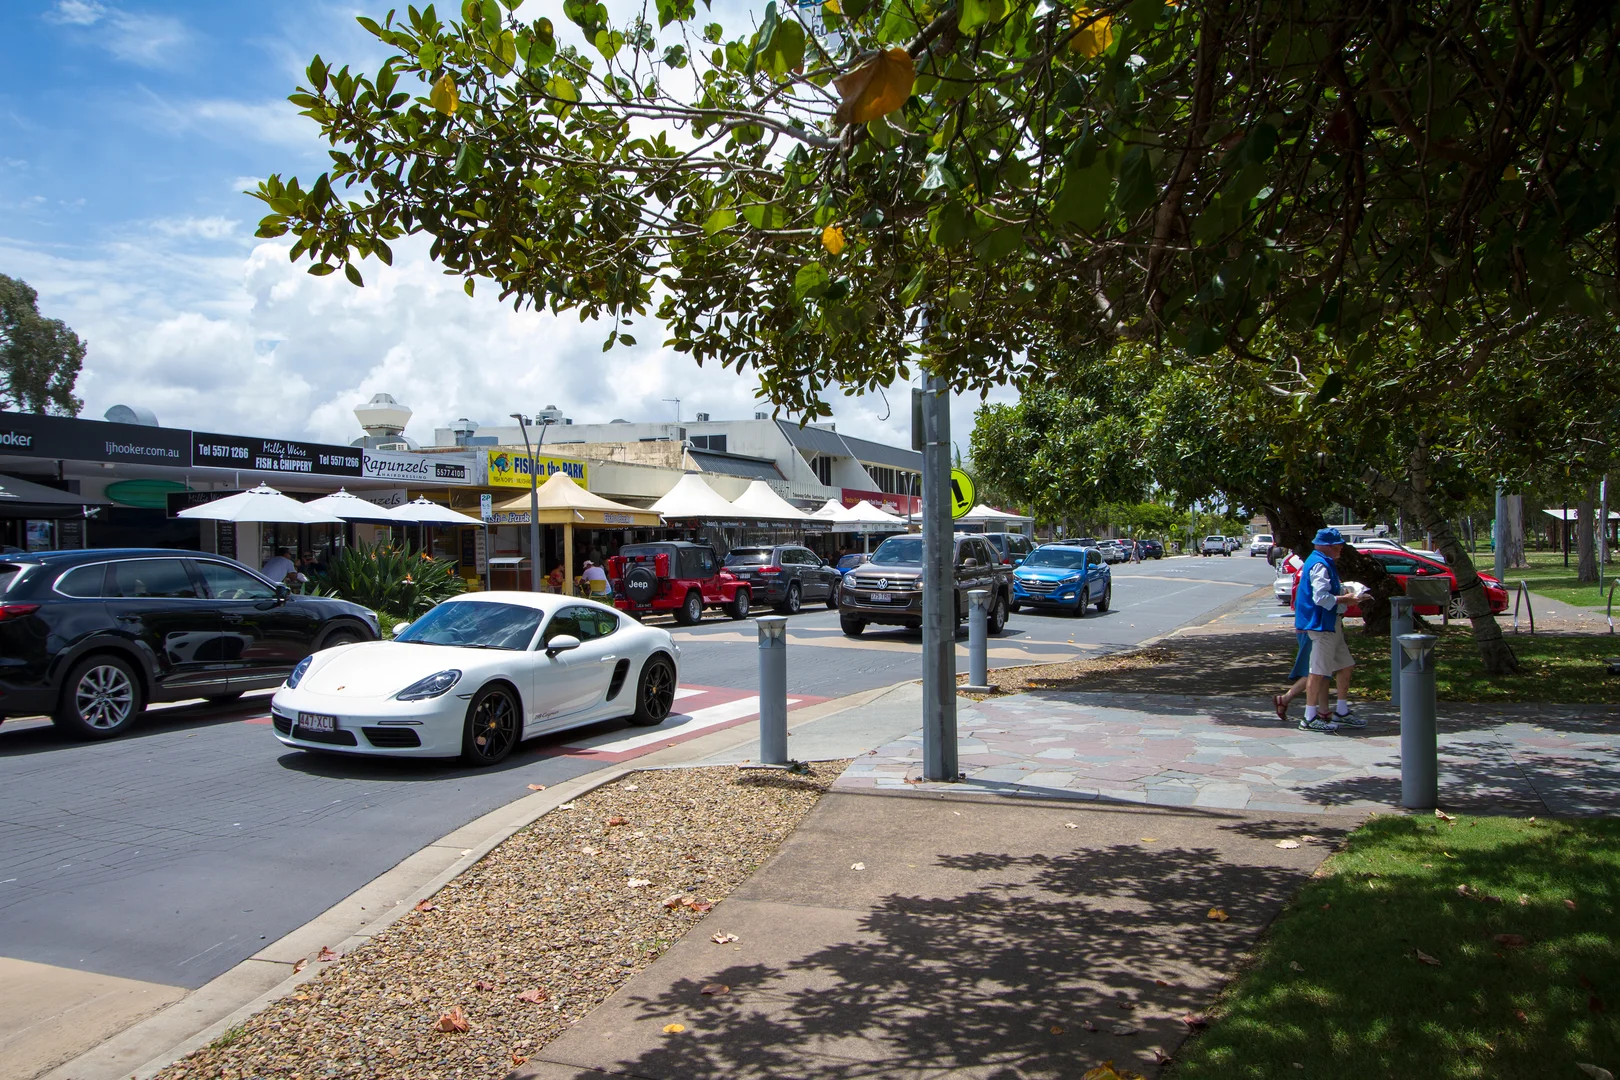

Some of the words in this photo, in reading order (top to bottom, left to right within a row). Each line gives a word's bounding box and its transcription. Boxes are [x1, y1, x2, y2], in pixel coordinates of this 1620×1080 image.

[0, 431, 32, 446] oker
[105, 441, 180, 458] ljhooker.com.au
[198, 443, 211, 456] Tel
[212, 445, 229, 457] 5577
[231, 447, 249, 459] 1266
[255, 457, 272, 469] FISH
[273, 461, 279, 470] &
[280, 459, 313, 472] CHIPPERY
[319, 454, 329, 465] Tel
[330, 455, 344, 466] 5577
[345, 457, 359, 468] 1266
[362, 455, 429, 476] Rapunzels
[547, 461, 560, 476] the
[562, 462, 584, 479] PARK
[508, 512, 531, 522] Park
[629, 580, 648, 589] Jeep
